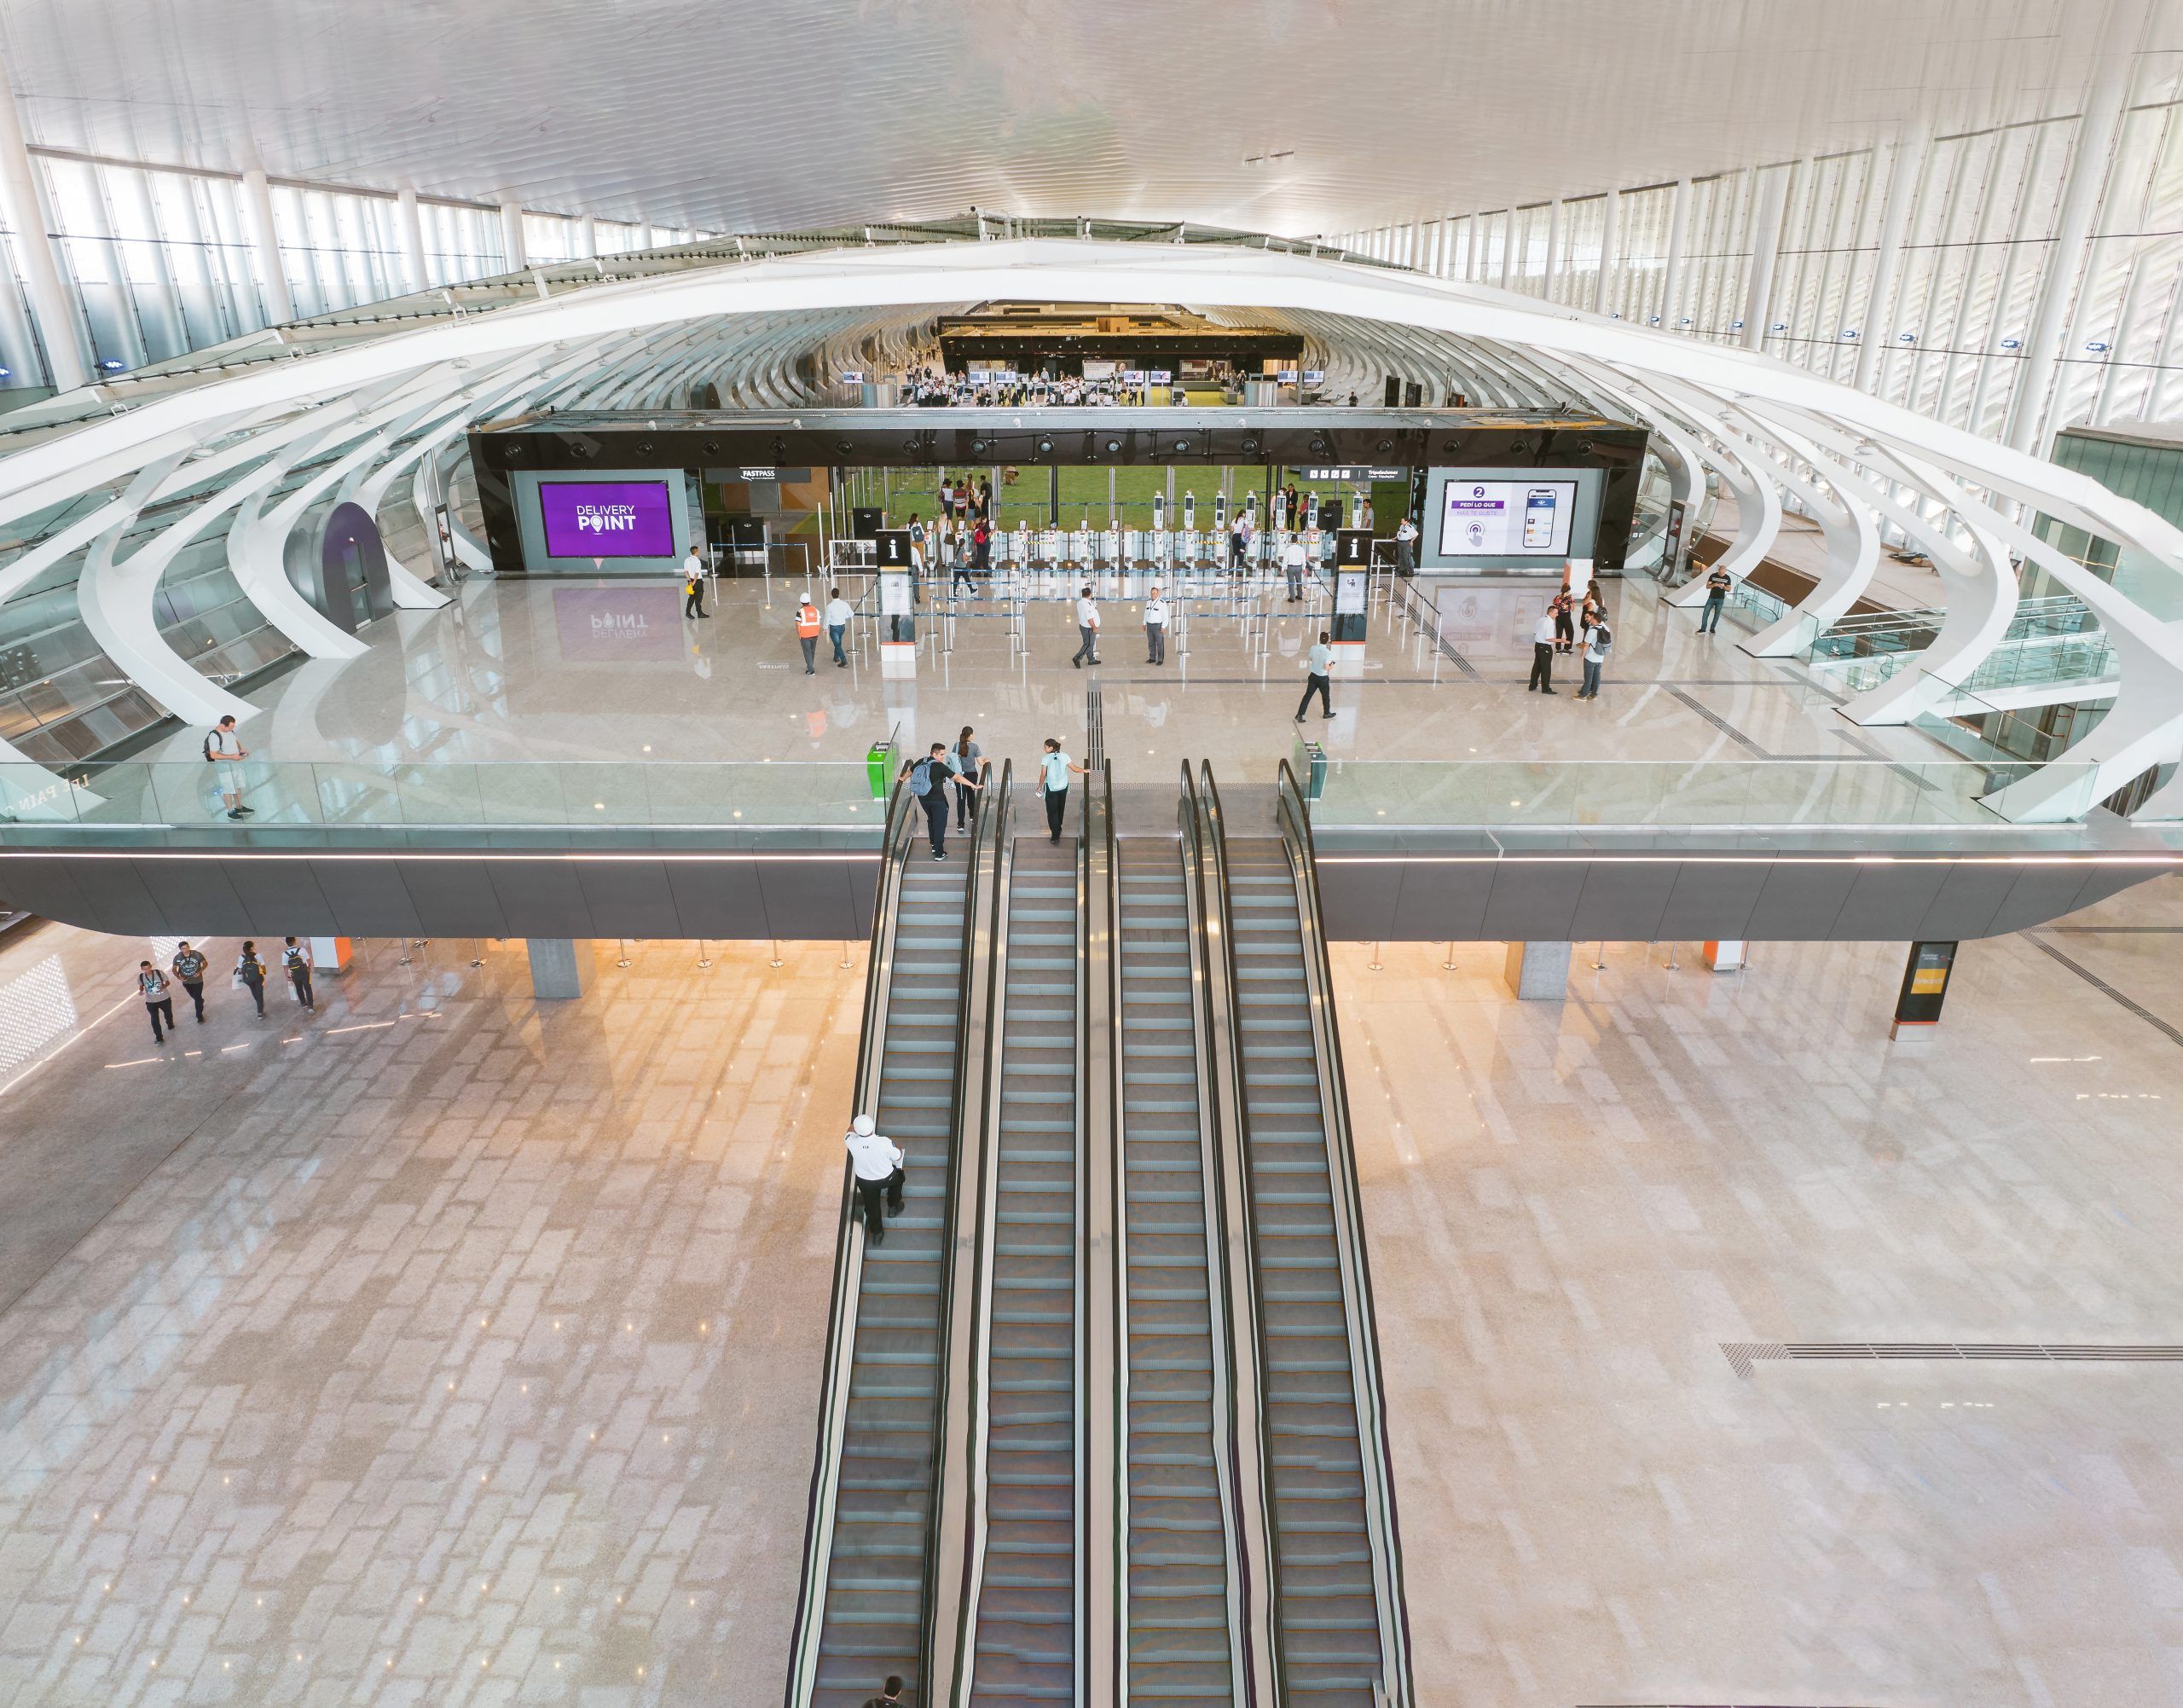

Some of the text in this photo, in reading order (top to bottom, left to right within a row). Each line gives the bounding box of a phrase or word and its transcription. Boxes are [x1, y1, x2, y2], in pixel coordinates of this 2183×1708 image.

[1474, 488, 1483, 497] 2
[576, 505, 634, 515] DELIVERY
[578, 515, 636, 533] POINT
